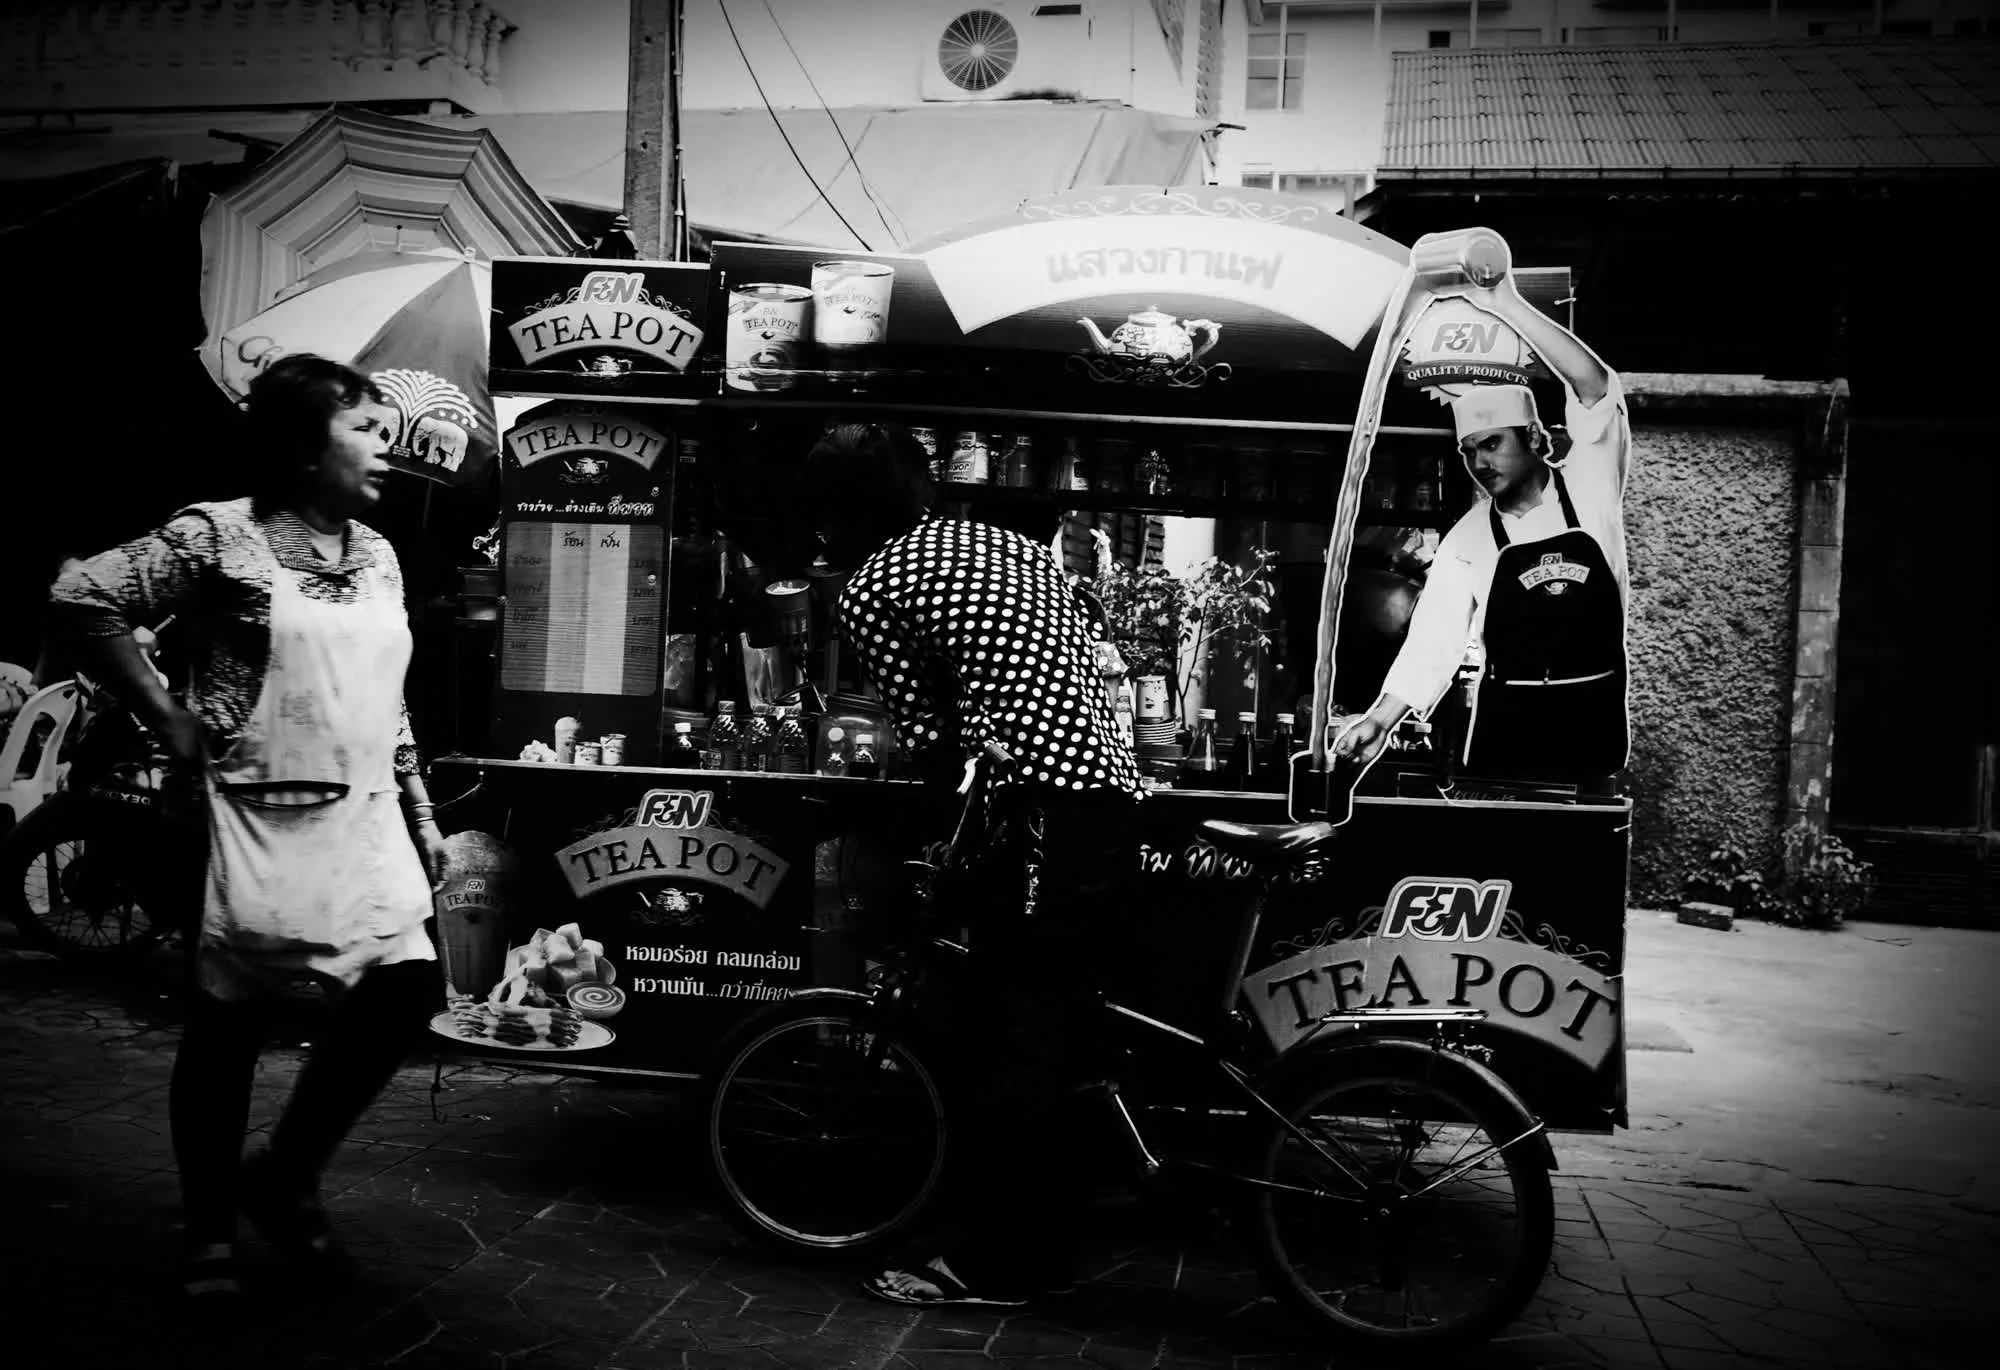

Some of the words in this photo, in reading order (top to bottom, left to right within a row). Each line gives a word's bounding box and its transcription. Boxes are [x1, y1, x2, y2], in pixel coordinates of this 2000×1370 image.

[1046, 245, 1286, 290] แสวงกาแฟ
[583, 276, 639, 304] F&N
[522, 313, 602, 353] TEA
[610, 311, 695, 357] POT
[744, 319, 768, 330] TEA
[771, 317, 794, 331] POT
[1431, 322, 1501, 354] F&N
[1407, 365, 1460, 380] QUALITY
[1465, 364, 1529, 385] PRODUCTS
[517, 424, 584, 458] TEA
[588, 421, 659, 459] POT
[1523, 568, 1554, 586] TEA
[1559, 565, 1587, 580] POT
[639, 794, 710, 827] F&N
[571, 837, 666, 885] TEA
[677, 835, 777, 891] POT
[446, 893, 471, 907] TEA
[1381, 884, 1502, 940] F&N
[625, 944, 708, 965] หอมอร่อย
[716, 950, 801, 971] กลมกล่อม
[1268, 954, 1429, 1029] TEA
[1451, 952, 1618, 1041] POT
